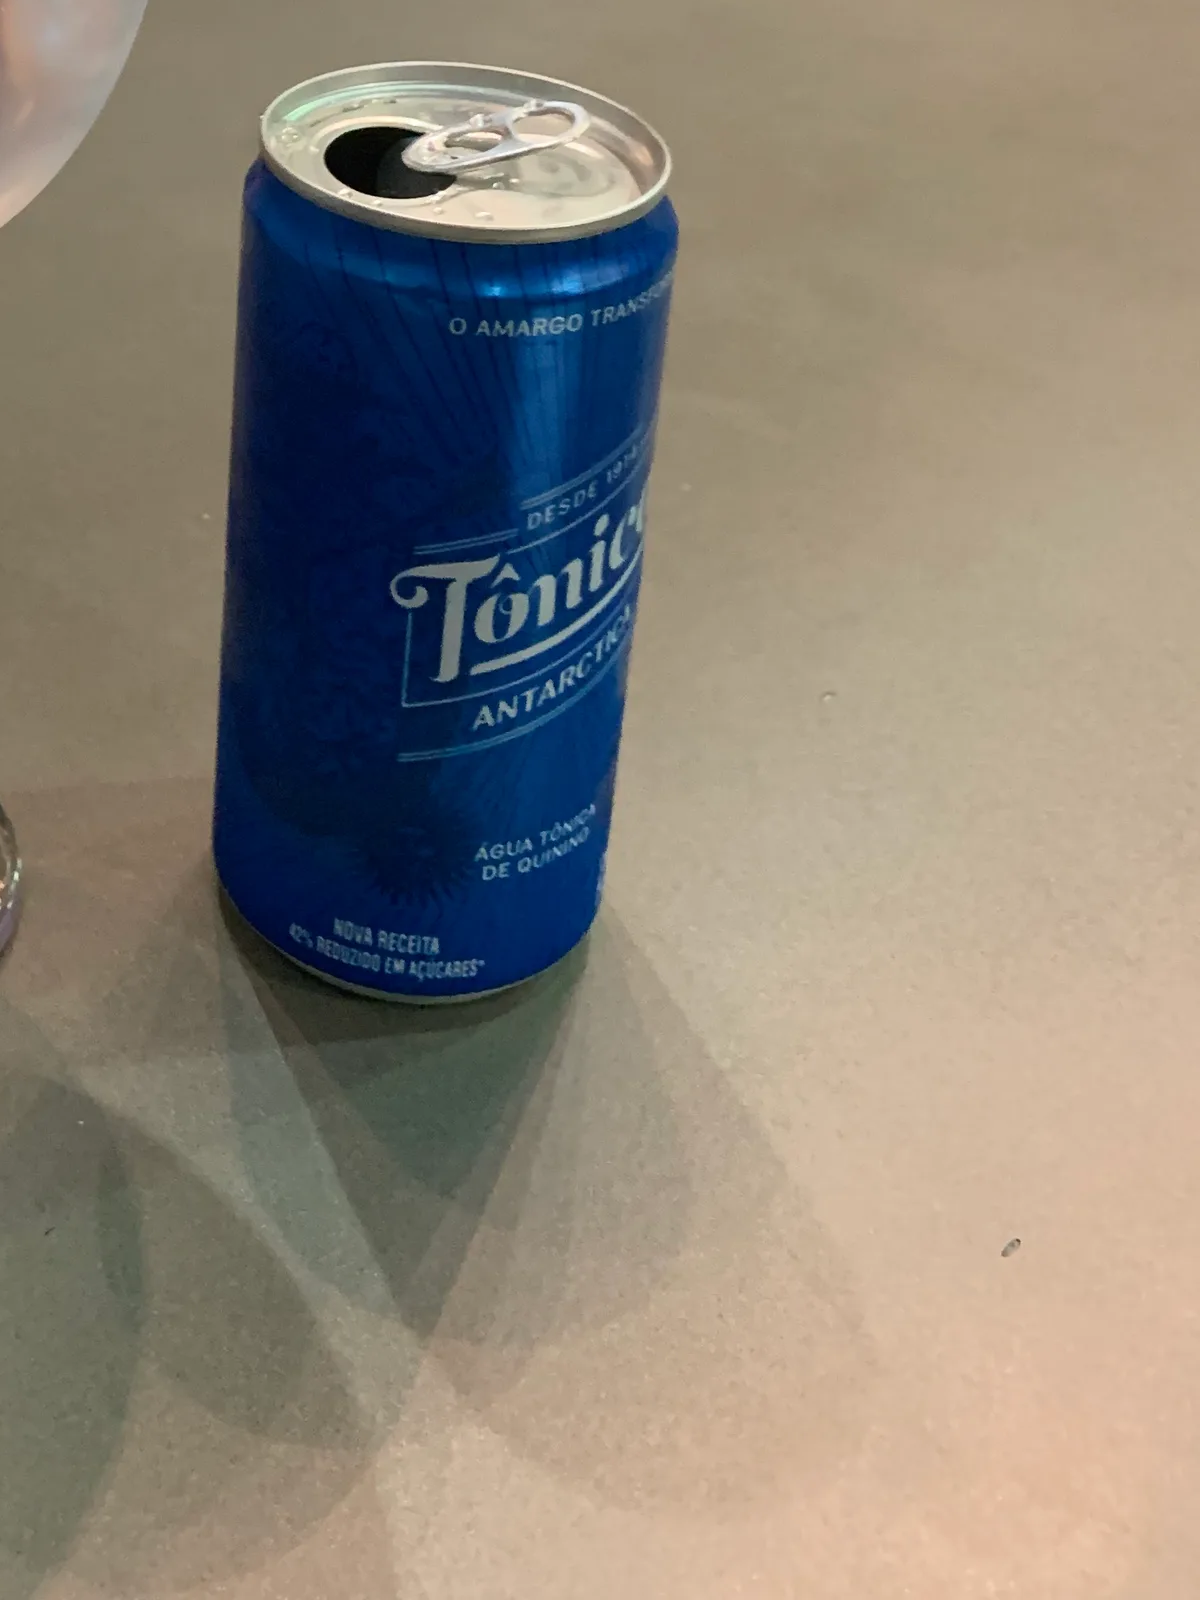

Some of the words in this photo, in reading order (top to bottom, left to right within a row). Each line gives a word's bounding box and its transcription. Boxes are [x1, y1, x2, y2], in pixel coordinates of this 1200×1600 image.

[449, 317, 467, 336] O
[476, 314, 583, 337] AMARGO
[527, 480, 598, 531] DESDE
[474, 836, 533, 862] ÁGUA
[482, 861, 511, 881] DE
[333, 917, 373, 947] NOVA
[377, 930, 441, 956] RECEITA
[316, 935, 381, 973] REDUZIDO
[384, 956, 406, 975] EM
